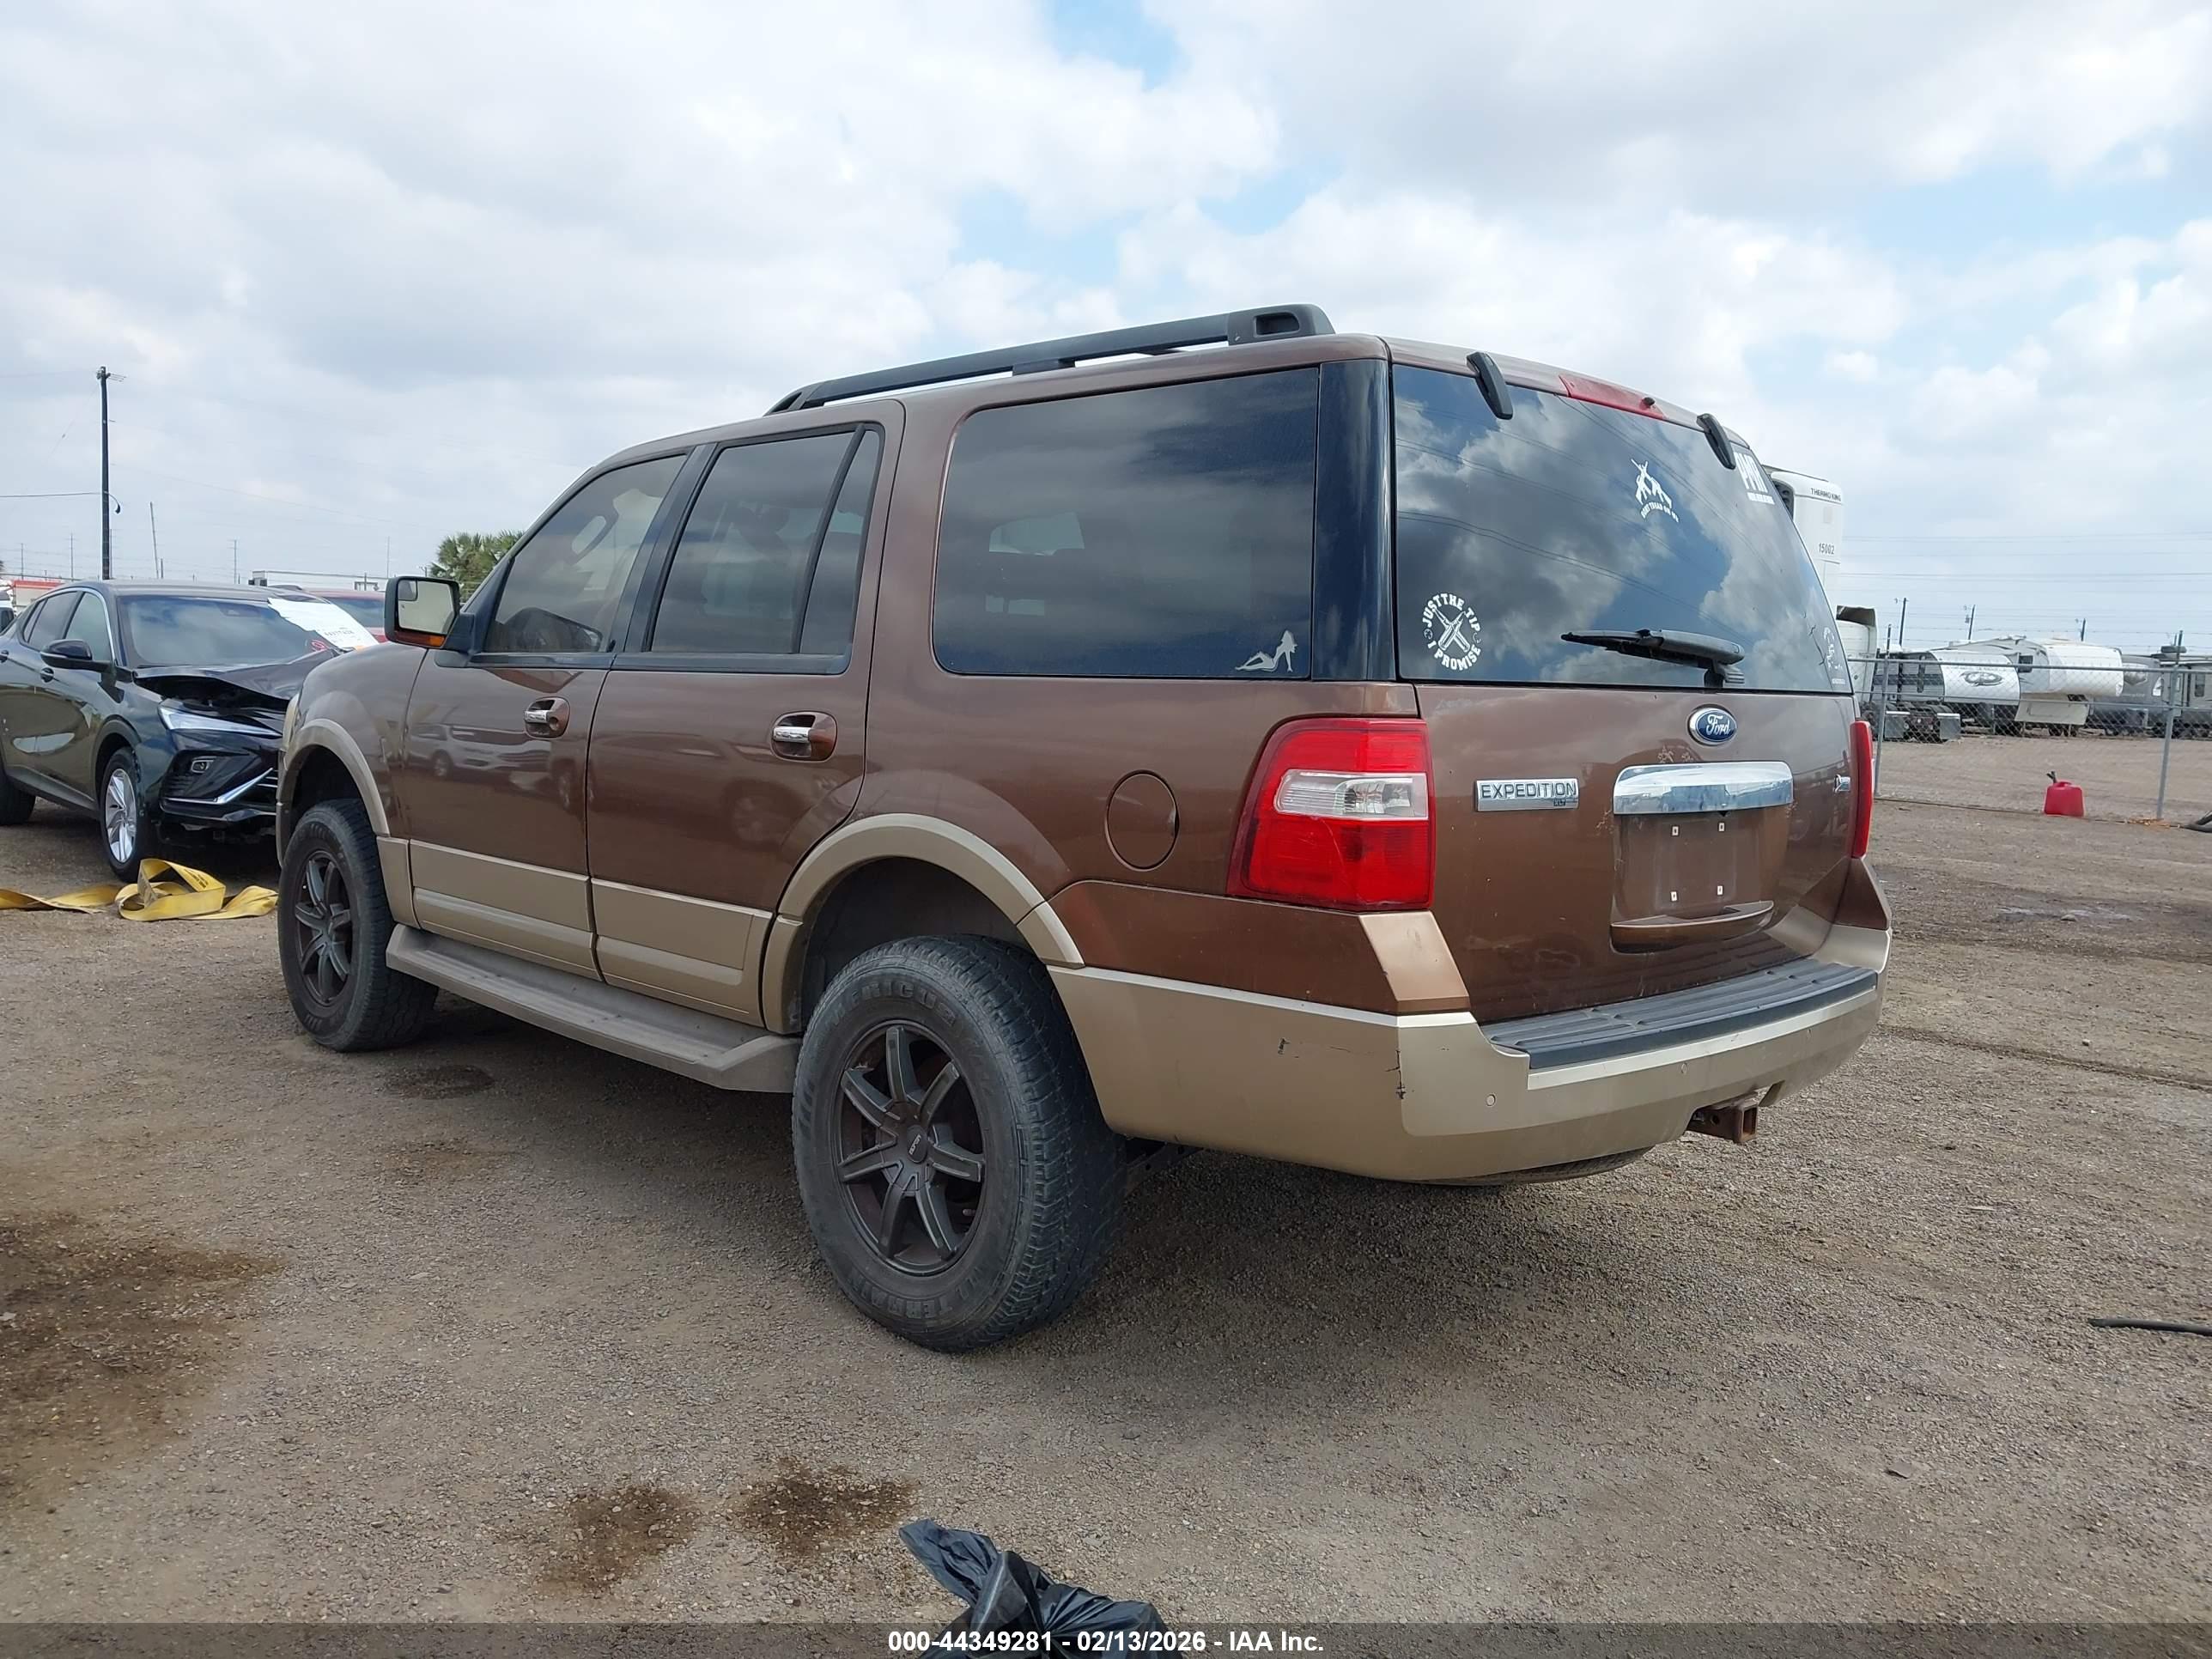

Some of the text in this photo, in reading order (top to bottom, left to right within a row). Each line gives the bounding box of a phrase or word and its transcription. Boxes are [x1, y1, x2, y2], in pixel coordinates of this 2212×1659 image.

[1818, 543, 1835, 555] 15002
[1422, 592, 1480, 632] JUST THE TIP
[1427, 640, 1481, 671] I PROMISE
[1705, 714, 1731, 736] Ford
[1480, 782, 1577, 799] EXPEDITION
